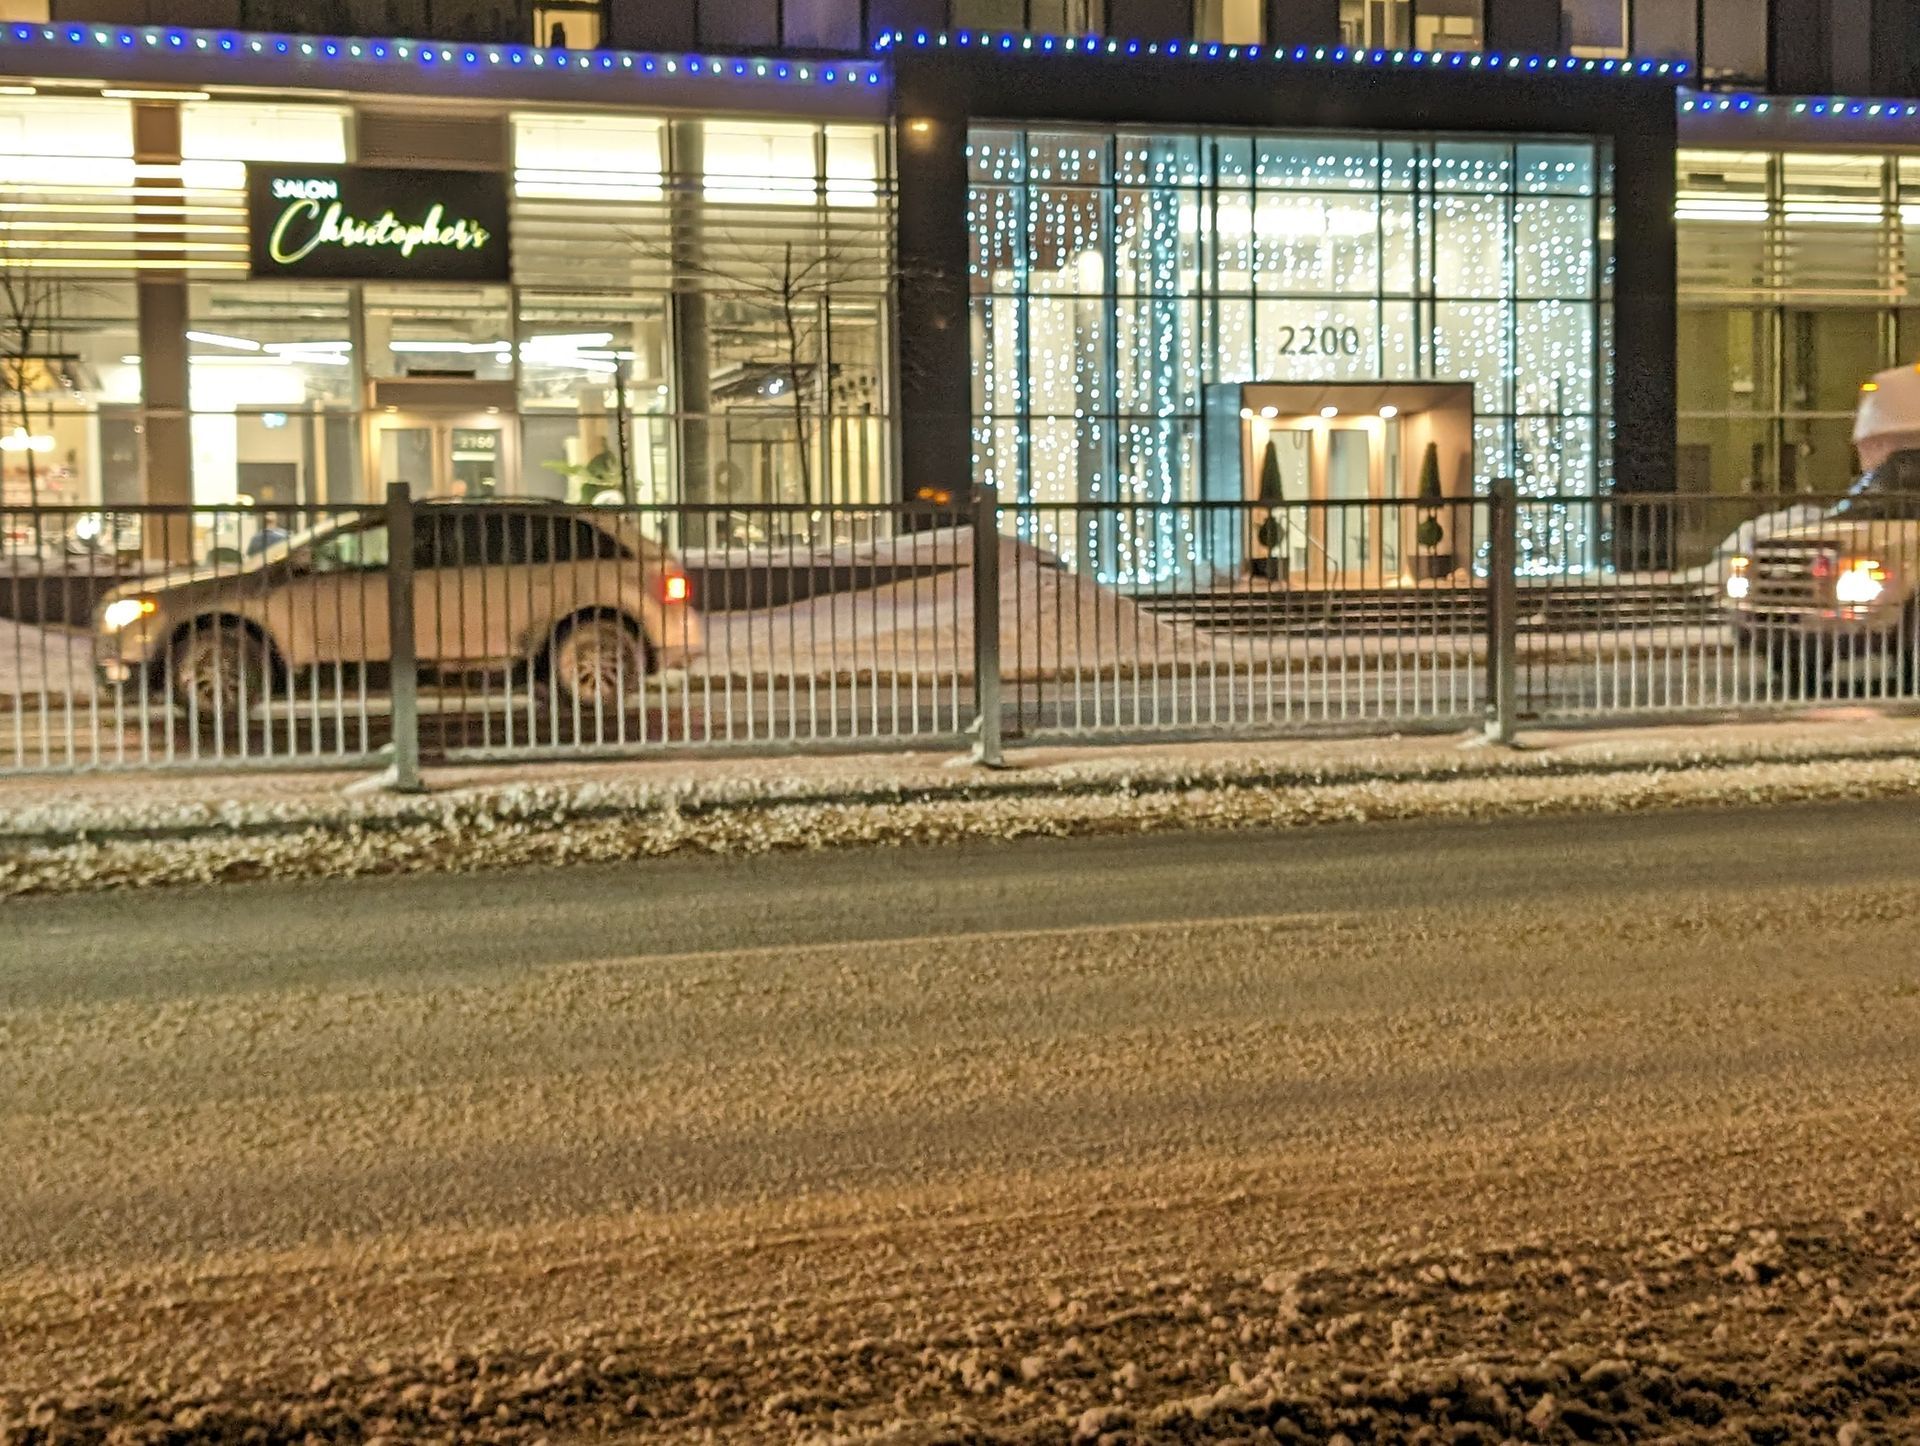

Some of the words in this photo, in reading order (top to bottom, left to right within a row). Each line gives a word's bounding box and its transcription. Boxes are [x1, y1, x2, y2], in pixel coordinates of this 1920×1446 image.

[272, 179, 337, 199] SALON
[270, 199, 490, 264] Christopher's
[1279, 326, 1358, 355] 2200
